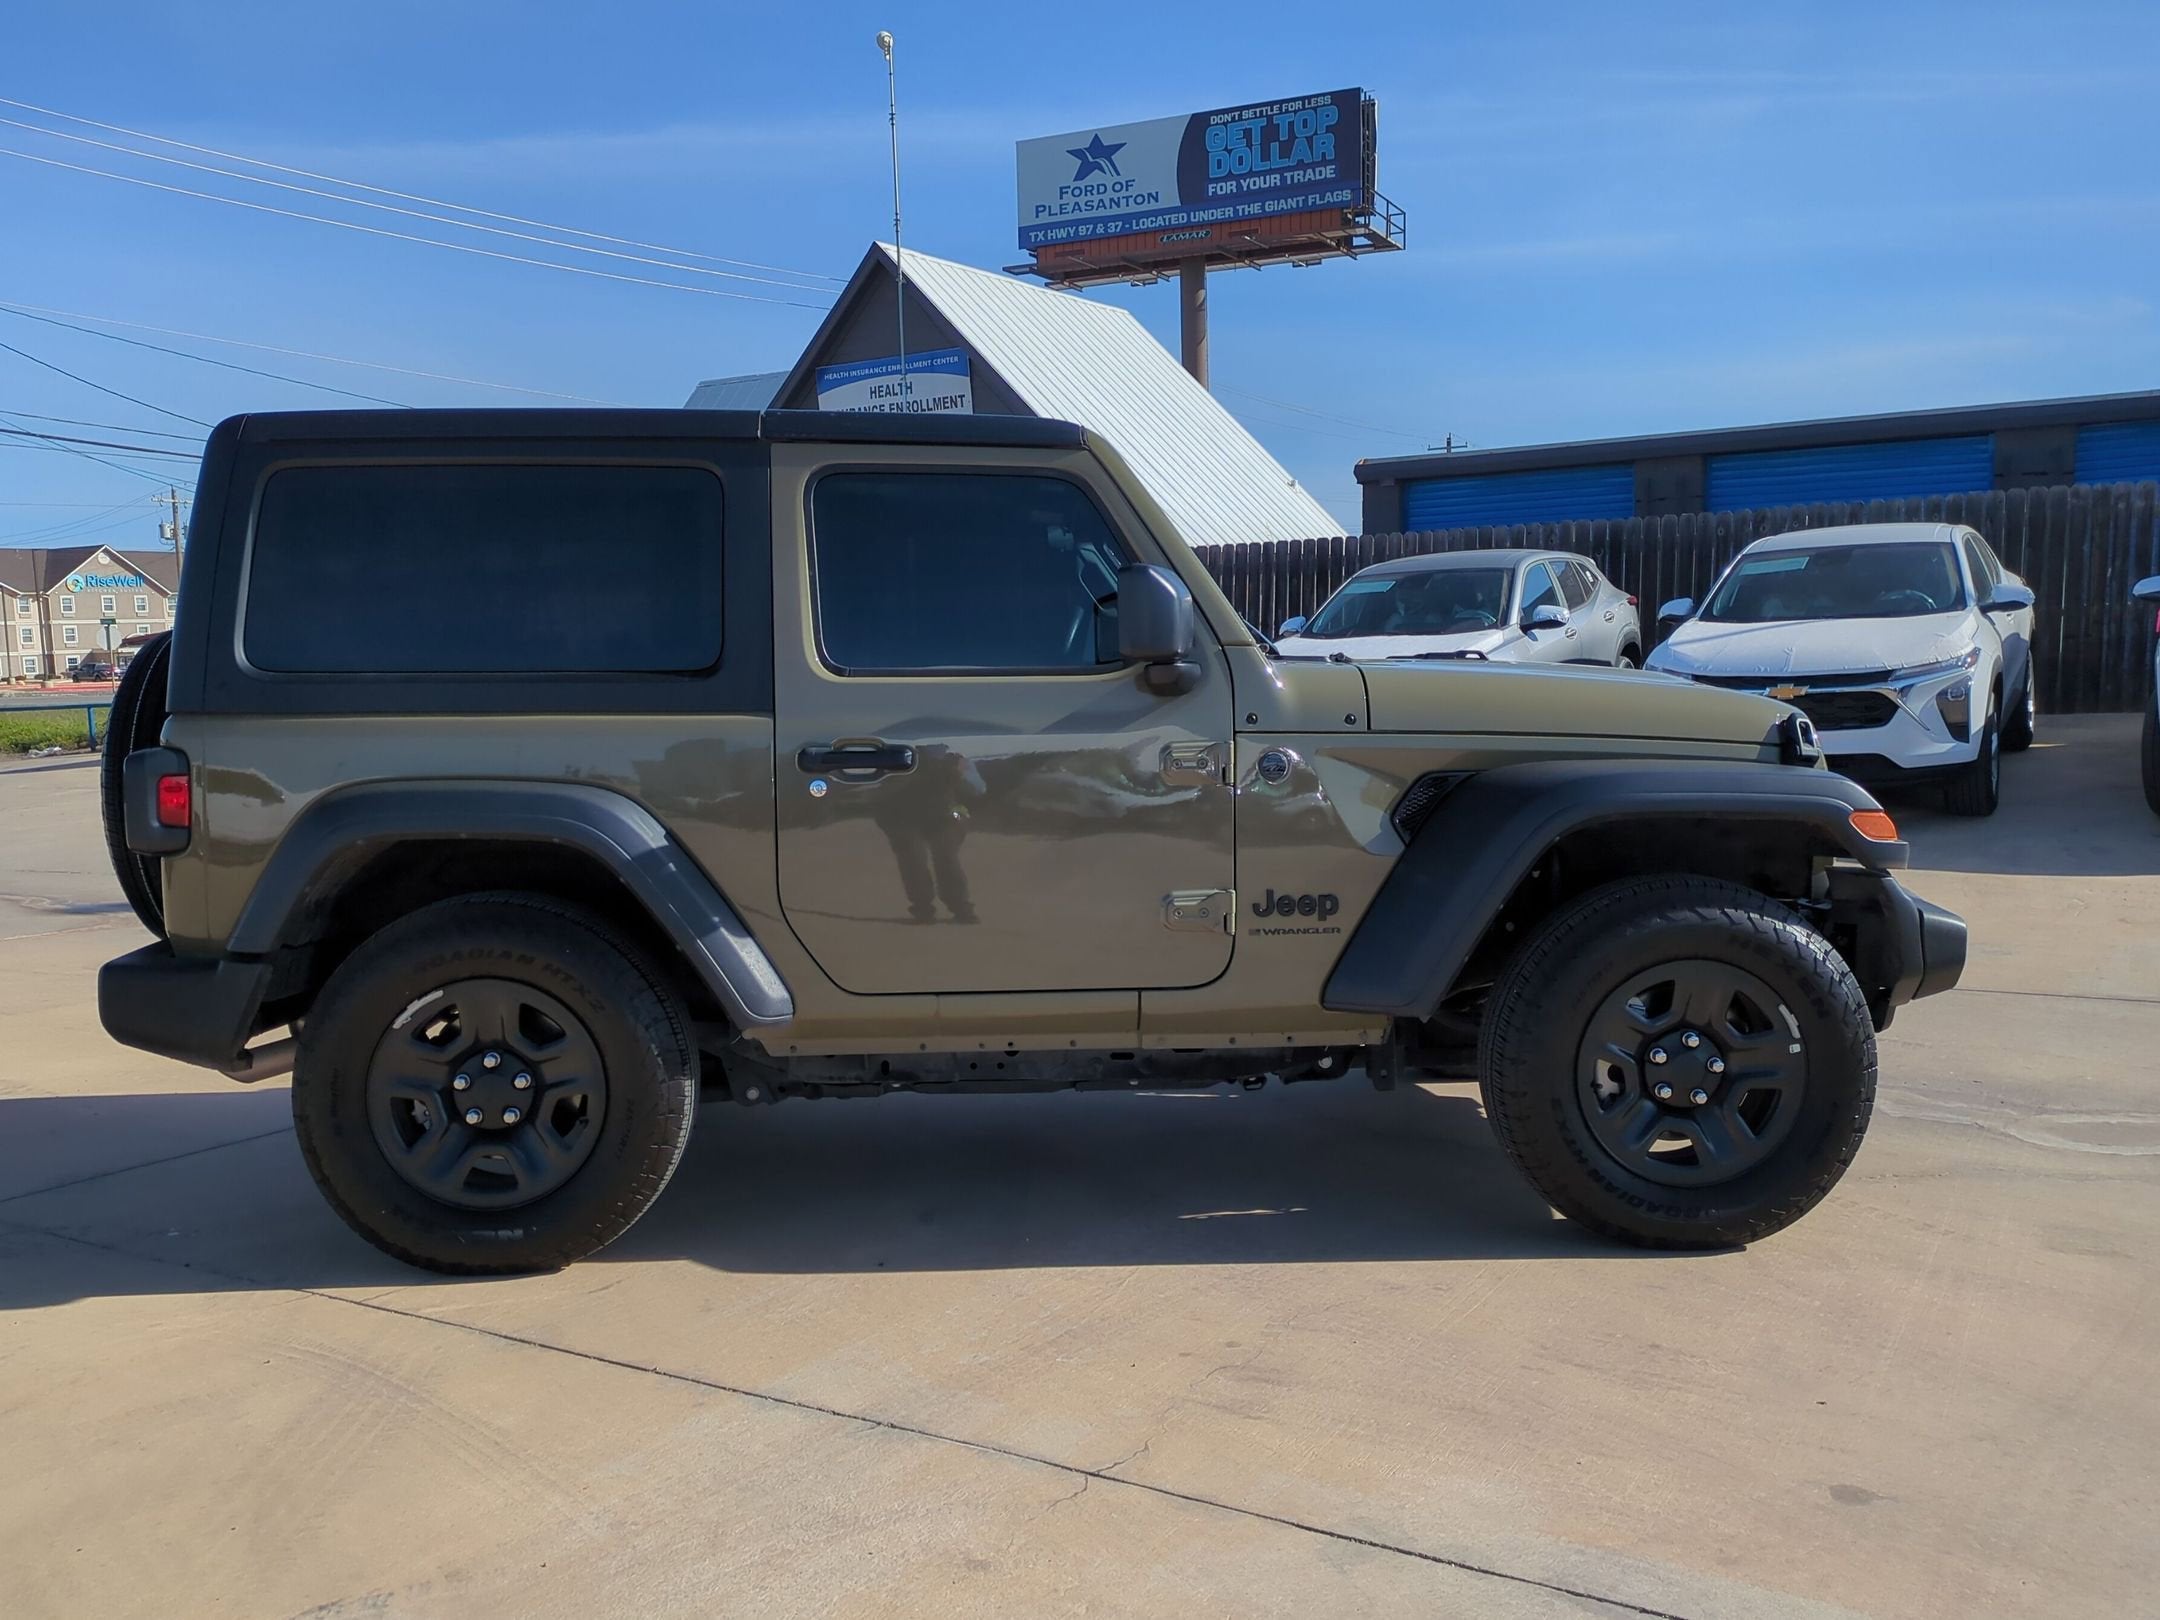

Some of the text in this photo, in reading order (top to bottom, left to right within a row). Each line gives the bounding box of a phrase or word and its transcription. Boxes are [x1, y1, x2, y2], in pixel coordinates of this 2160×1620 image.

[1210, 95, 1331, 125] DON'T SETTLE FOR LESS
[1205, 105, 1338, 152] GET TOP
[1208, 132, 1335, 179] DOLLAR
[1059, 179, 1136, 200] FORD OF
[1208, 165, 1336, 196] FOR YOUR TRADE
[1029, 230, 1045, 243] TX
[1047, 226, 1076, 240] HWY
[1078, 224, 1093, 236] 97
[1095, 223, 1105, 234] &
[1107, 221, 1123, 233] 37
[1132, 212, 1187, 230] LOCATED
[1190, 204, 1234, 222] UNDER
[1236, 200, 1262, 216] THE
[1264, 196, 1305, 213] GIANT
[1307, 189, 1351, 207] FLAGS
[1034, 191, 1159, 219] PLEASANTON
[1163, 229, 1207, 243] LAMAR
[824, 355, 959, 381] HEALTH INSURANCE ENRLLMENT CENTER
[869, 381, 913, 400] HEALTH
[85, 575, 145, 588] RiseWell
[1252, 888, 1340, 921] Jeep
[1263, 927, 1341, 936] WRANGLER
